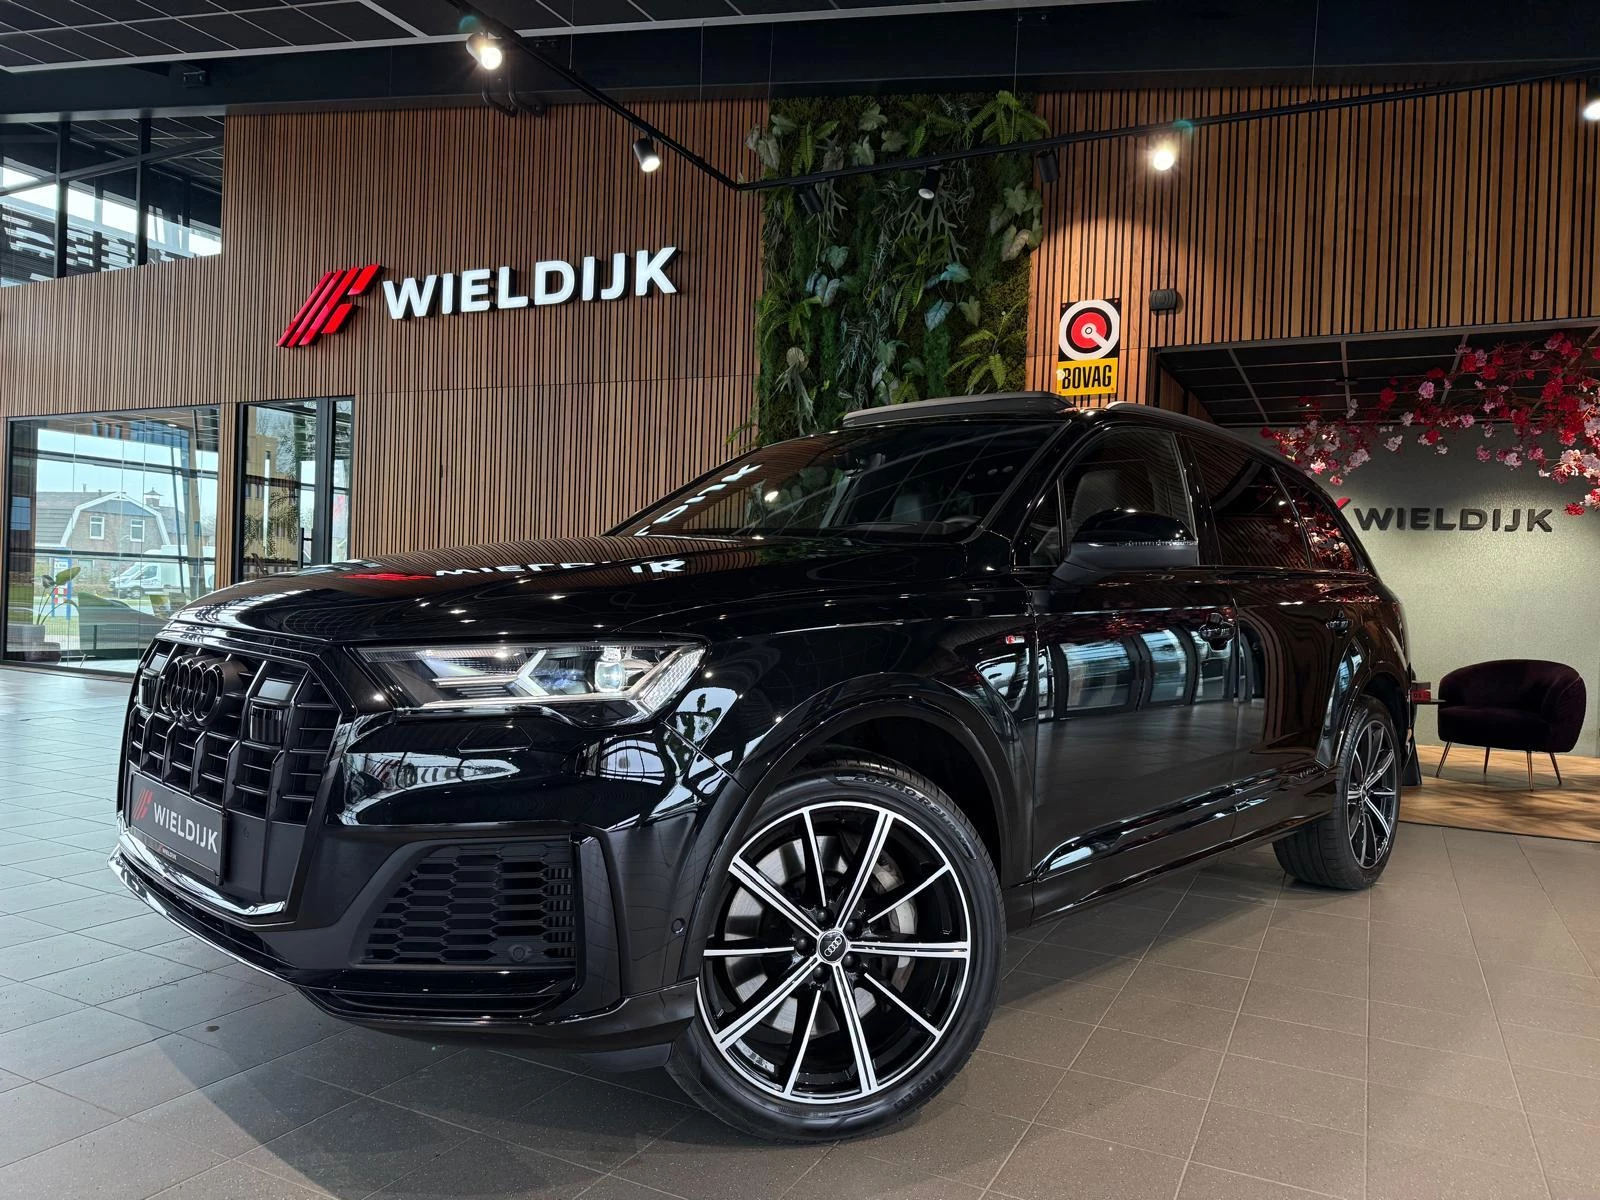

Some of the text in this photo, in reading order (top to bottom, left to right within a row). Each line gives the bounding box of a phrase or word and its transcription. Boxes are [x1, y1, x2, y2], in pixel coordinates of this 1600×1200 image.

[382, 246, 680, 320] WIELDIJK
[1061, 364, 1112, 390] BOVAG
[1353, 507, 1553, 532] WIELDIJK
[153, 802, 218, 854] WIELDIJK
